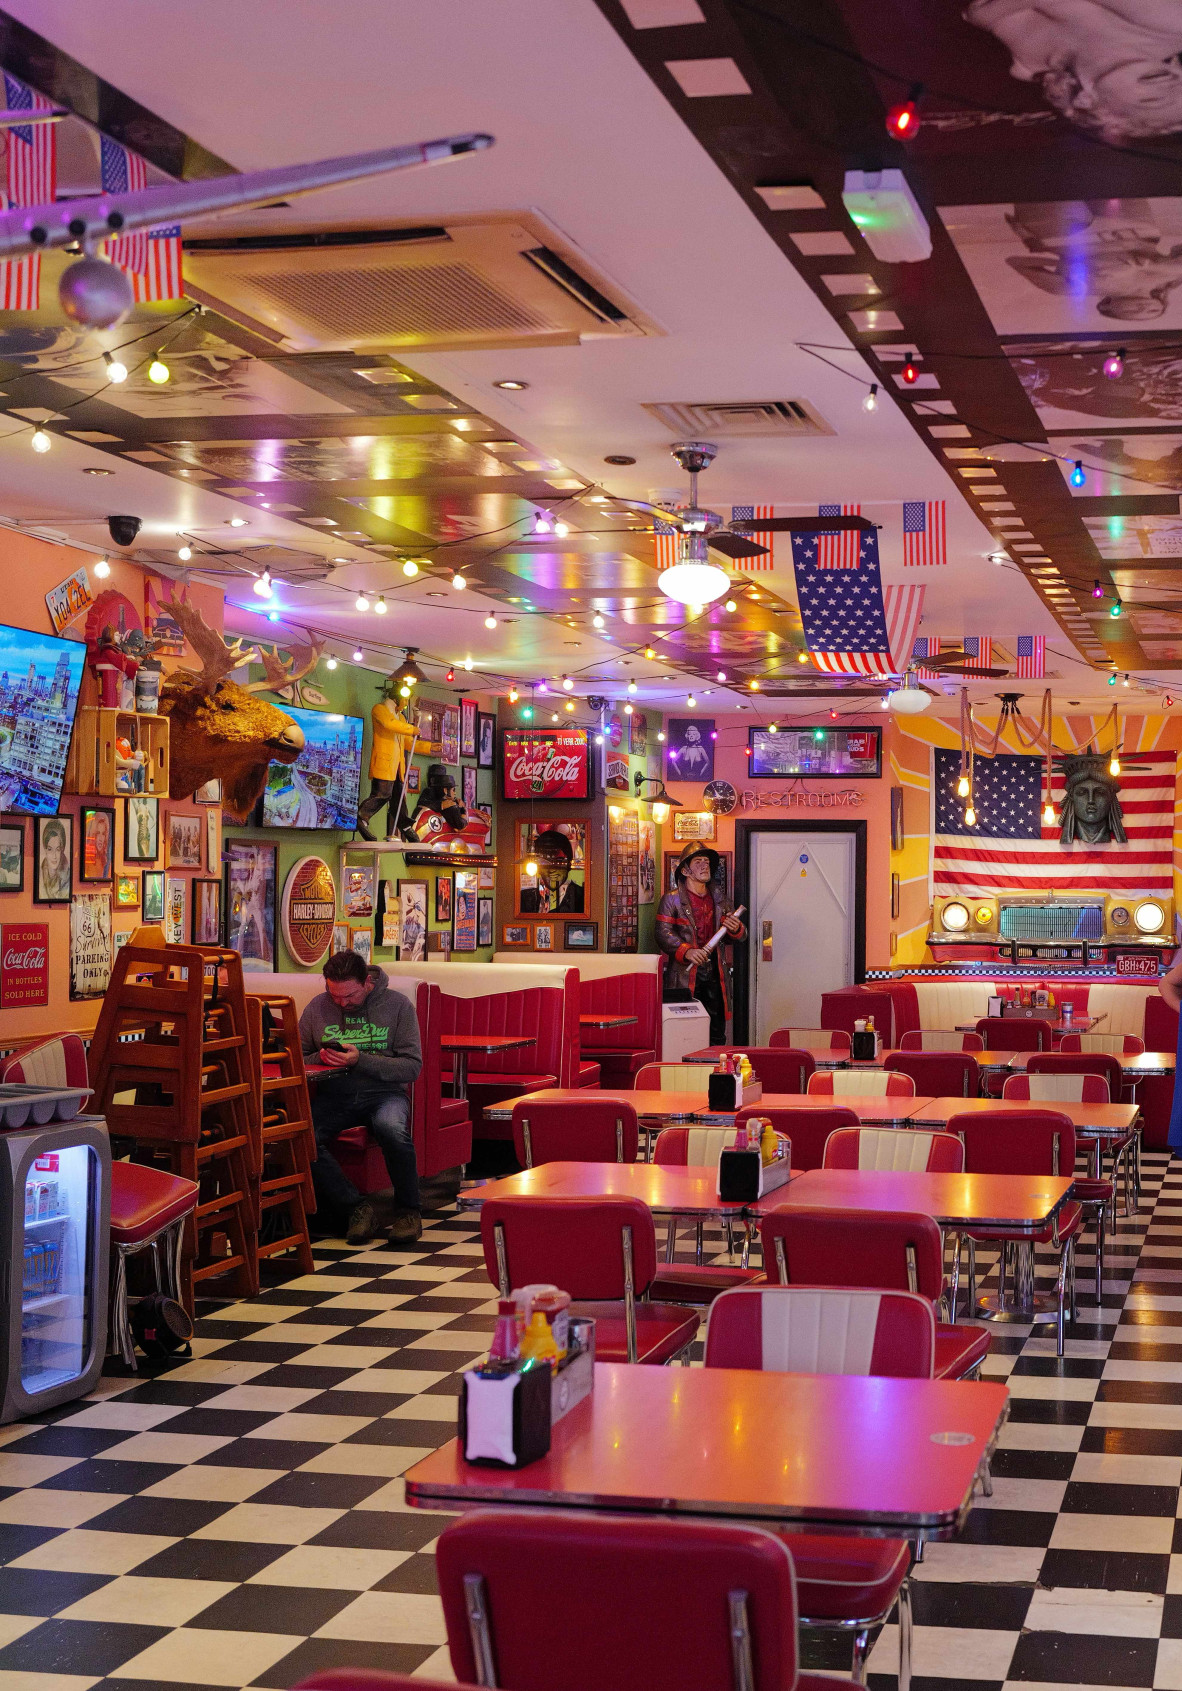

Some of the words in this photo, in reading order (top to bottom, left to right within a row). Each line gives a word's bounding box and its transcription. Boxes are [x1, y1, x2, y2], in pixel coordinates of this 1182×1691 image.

[510, 755, 582, 782] Coca-Cola
[743, 790, 863, 809] RESTROOMS
[293, 902, 334, 919] HARLEY-DAVIDSON
[8, 933, 20, 941] ICE
[22, 932, 42, 940] COLD
[3, 947, 46, 969] Coca-Cola
[1140, 961, 1156, 972] 475
[15, 977, 42, 985] BOTTLES
[5, 991, 24, 999] SOLD
[25, 990, 45, 998] HERE
